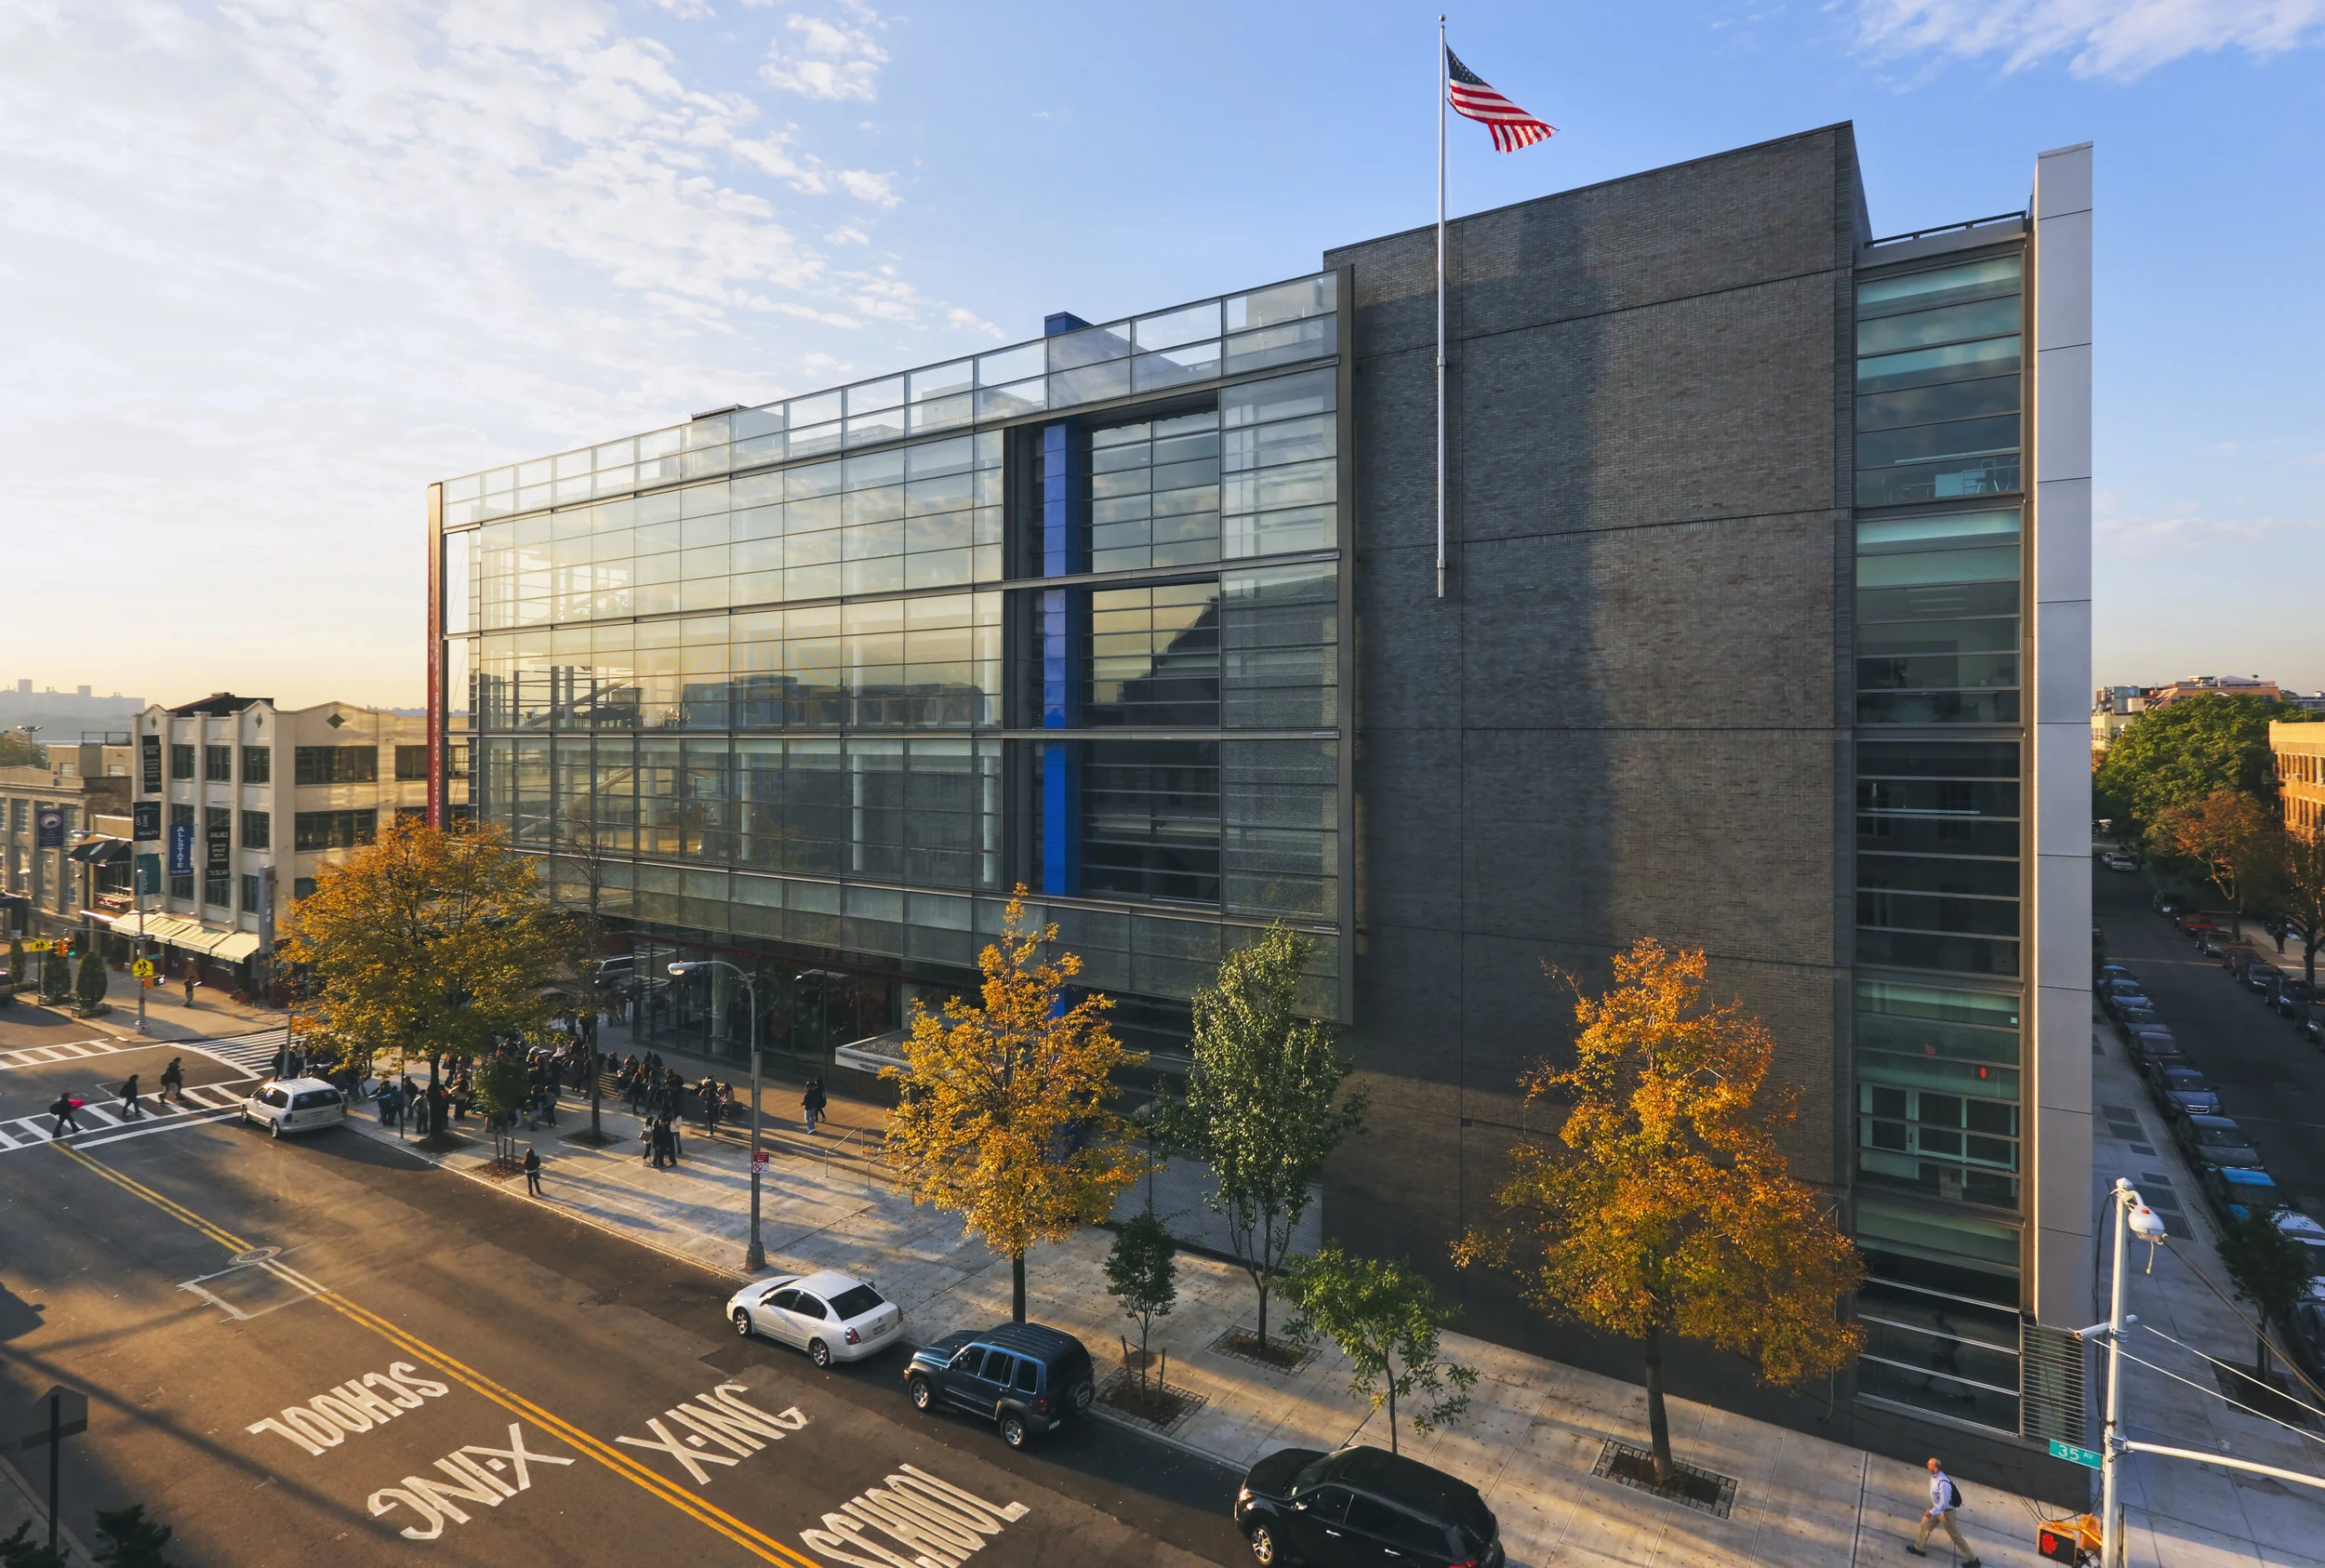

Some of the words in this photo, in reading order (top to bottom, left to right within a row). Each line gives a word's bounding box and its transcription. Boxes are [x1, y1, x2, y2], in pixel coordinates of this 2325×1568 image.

[244, 1361, 450, 1456] SCHOOL
[2057, 1444, 2079, 1461] 35
[2083, 1452, 2094, 1460] AV
